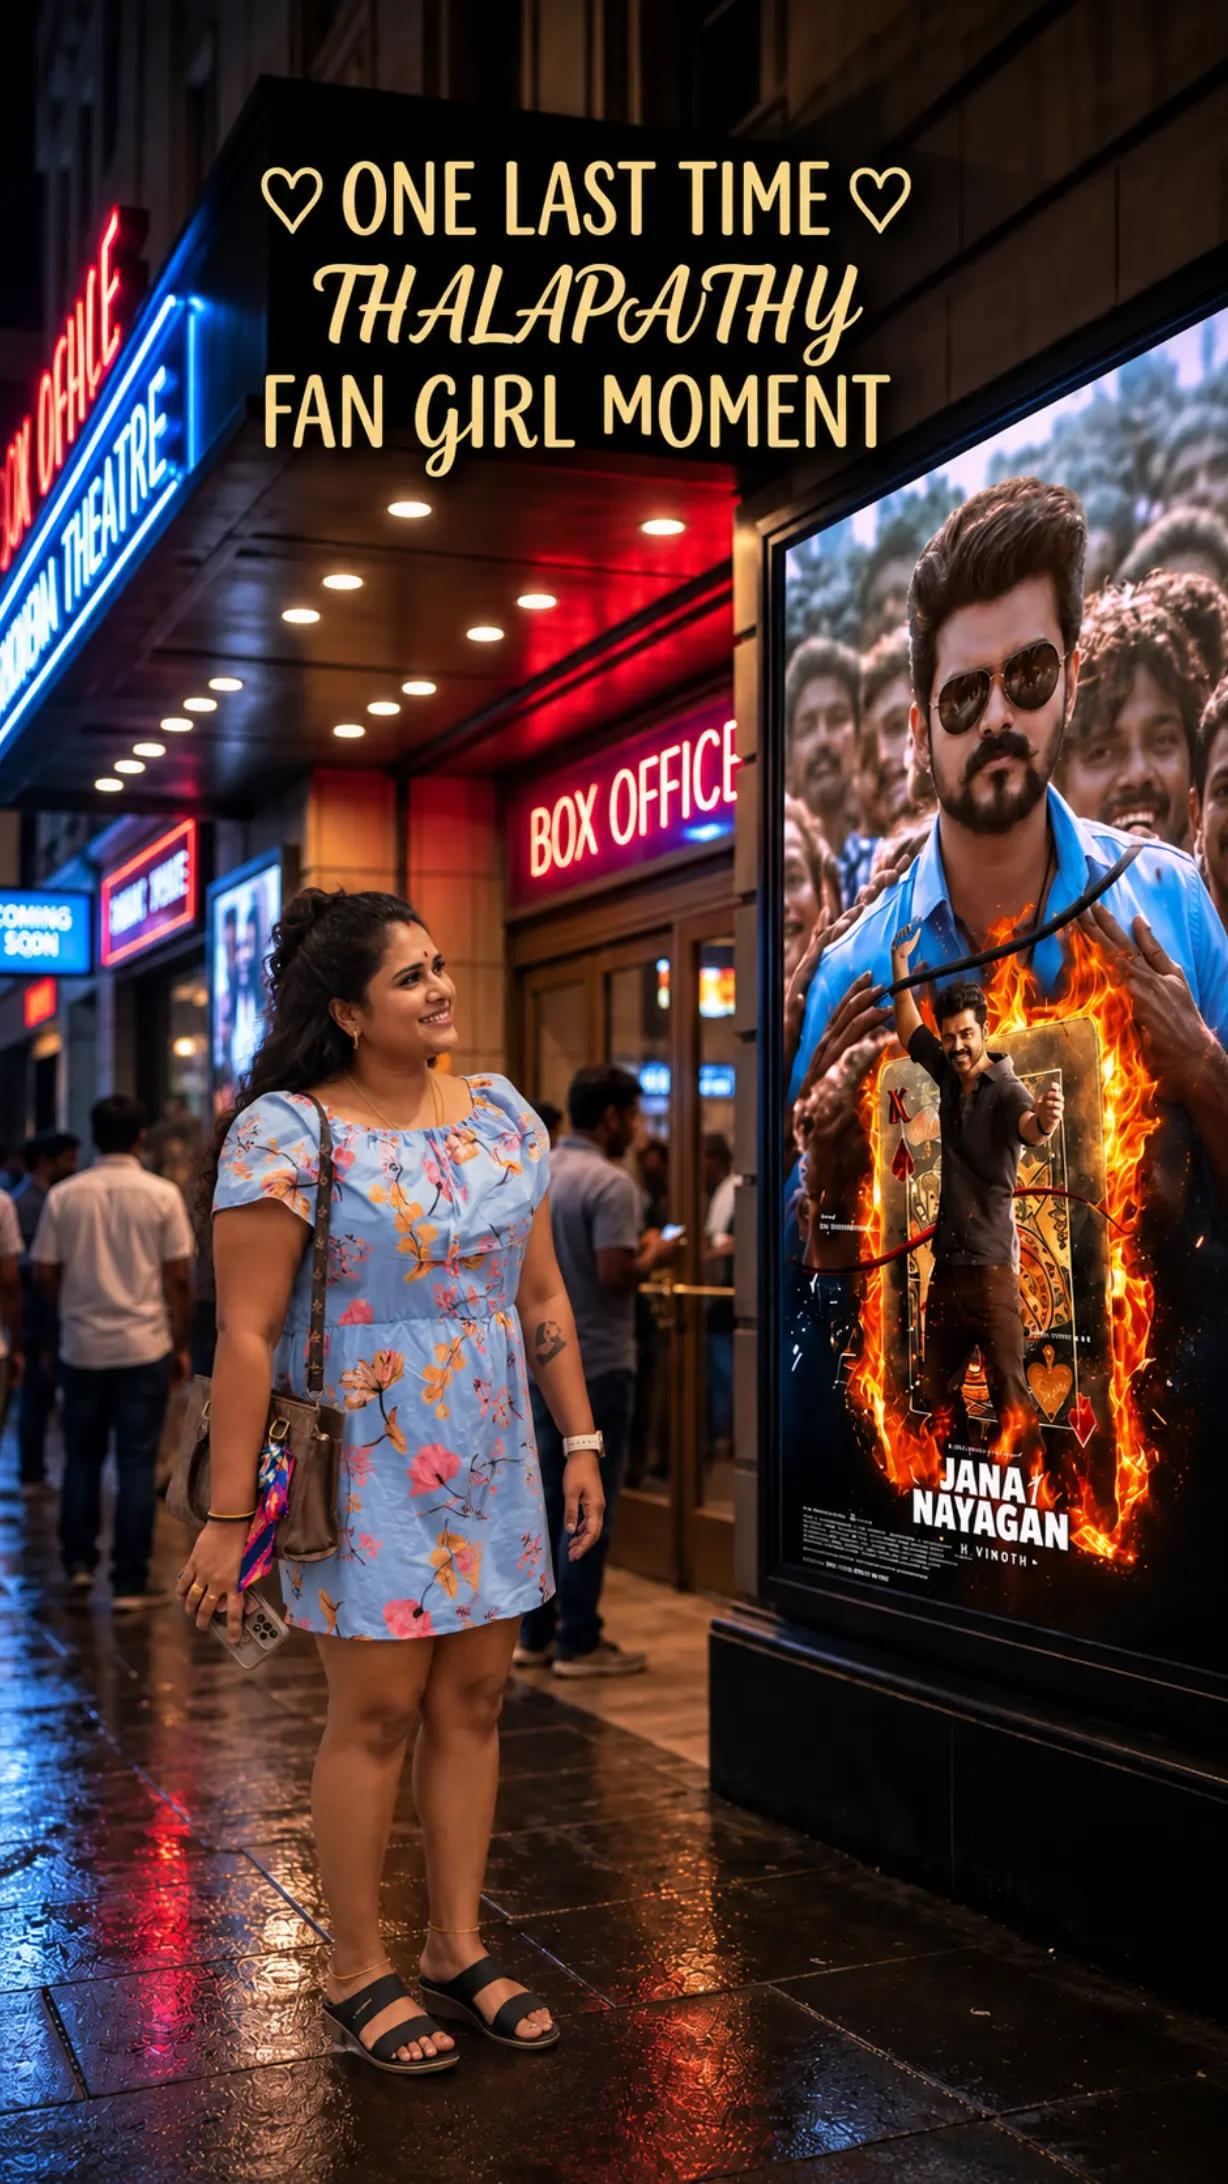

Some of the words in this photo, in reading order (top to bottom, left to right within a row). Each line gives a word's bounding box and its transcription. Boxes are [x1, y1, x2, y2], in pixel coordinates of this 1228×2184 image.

[61, 366, 167, 610] THEATRE
[530, 784, 598, 878] BOX
[609, 719, 738, 846] OFFICE
[0, 903, 72, 931] OMING
[940, 1457, 1026, 1504] JANA
[913, 1488, 1069, 1551] NAYAGAN
